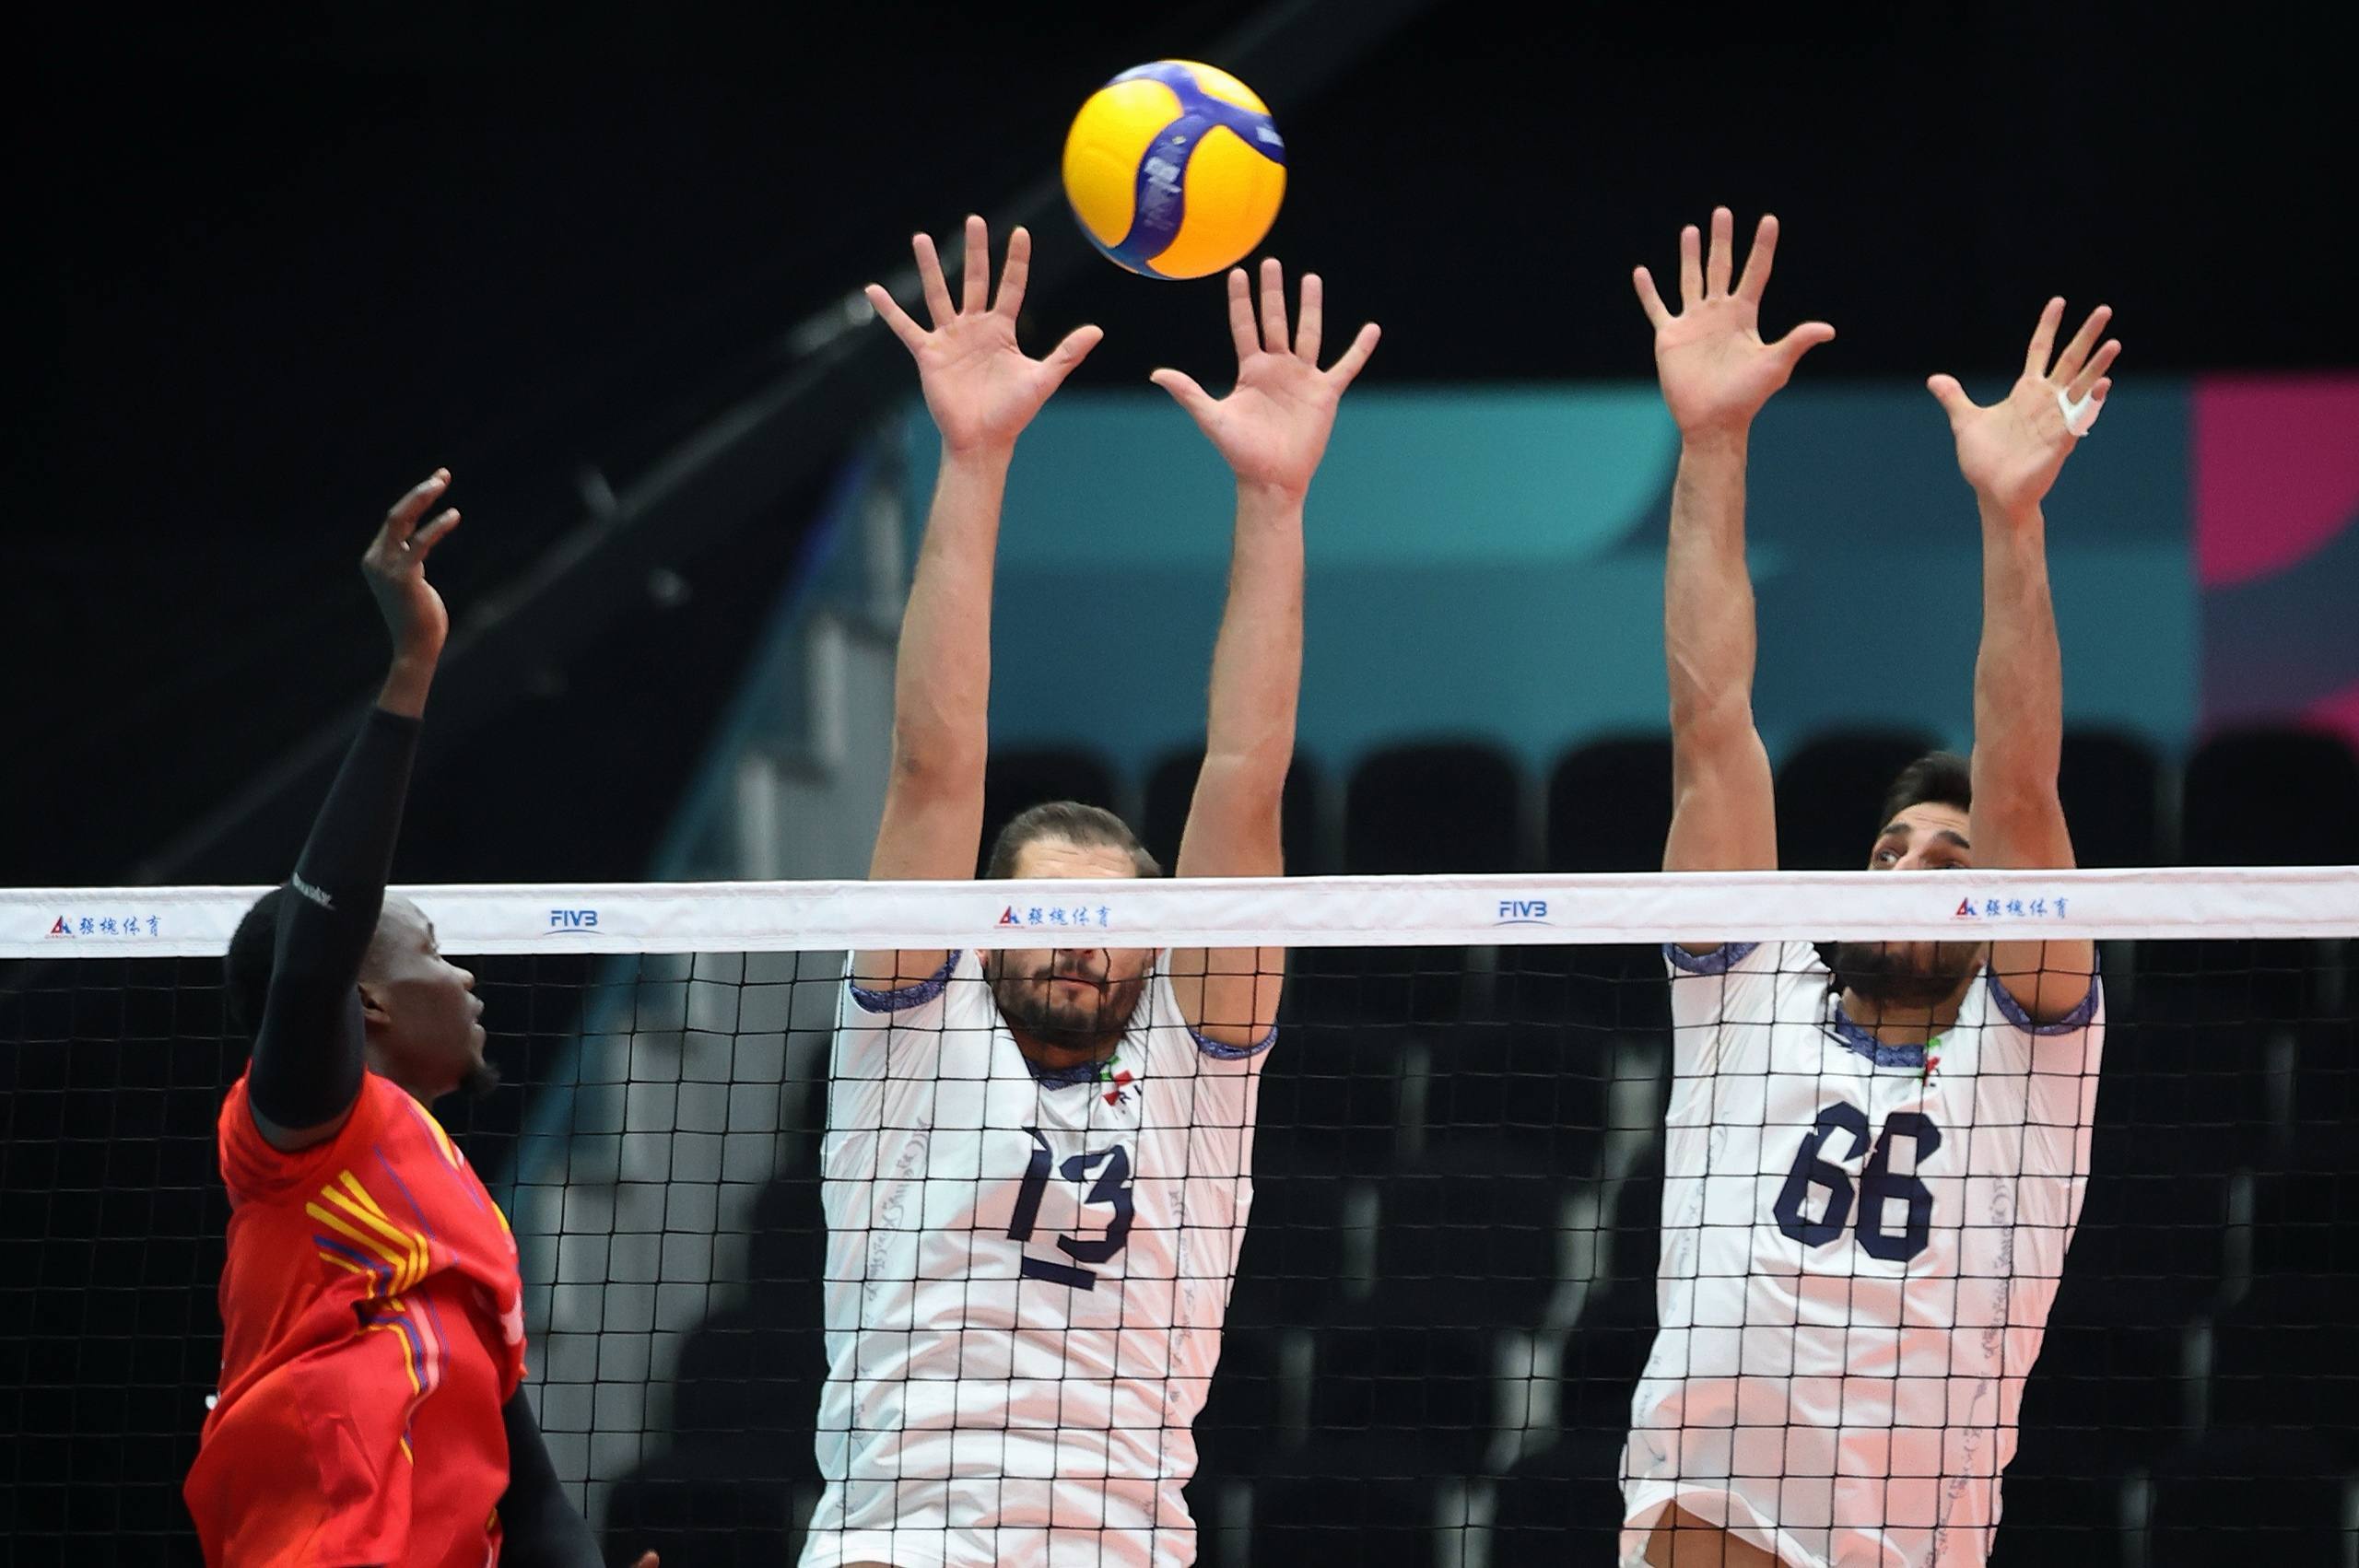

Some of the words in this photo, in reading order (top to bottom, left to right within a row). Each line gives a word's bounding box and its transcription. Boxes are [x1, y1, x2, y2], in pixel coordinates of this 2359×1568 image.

[550, 909, 598, 927] FIVB
[1499, 900, 1547, 918] FIVB
[1007, 1126, 1135, 1264] 13
[1773, 1101, 1942, 1261] 66
